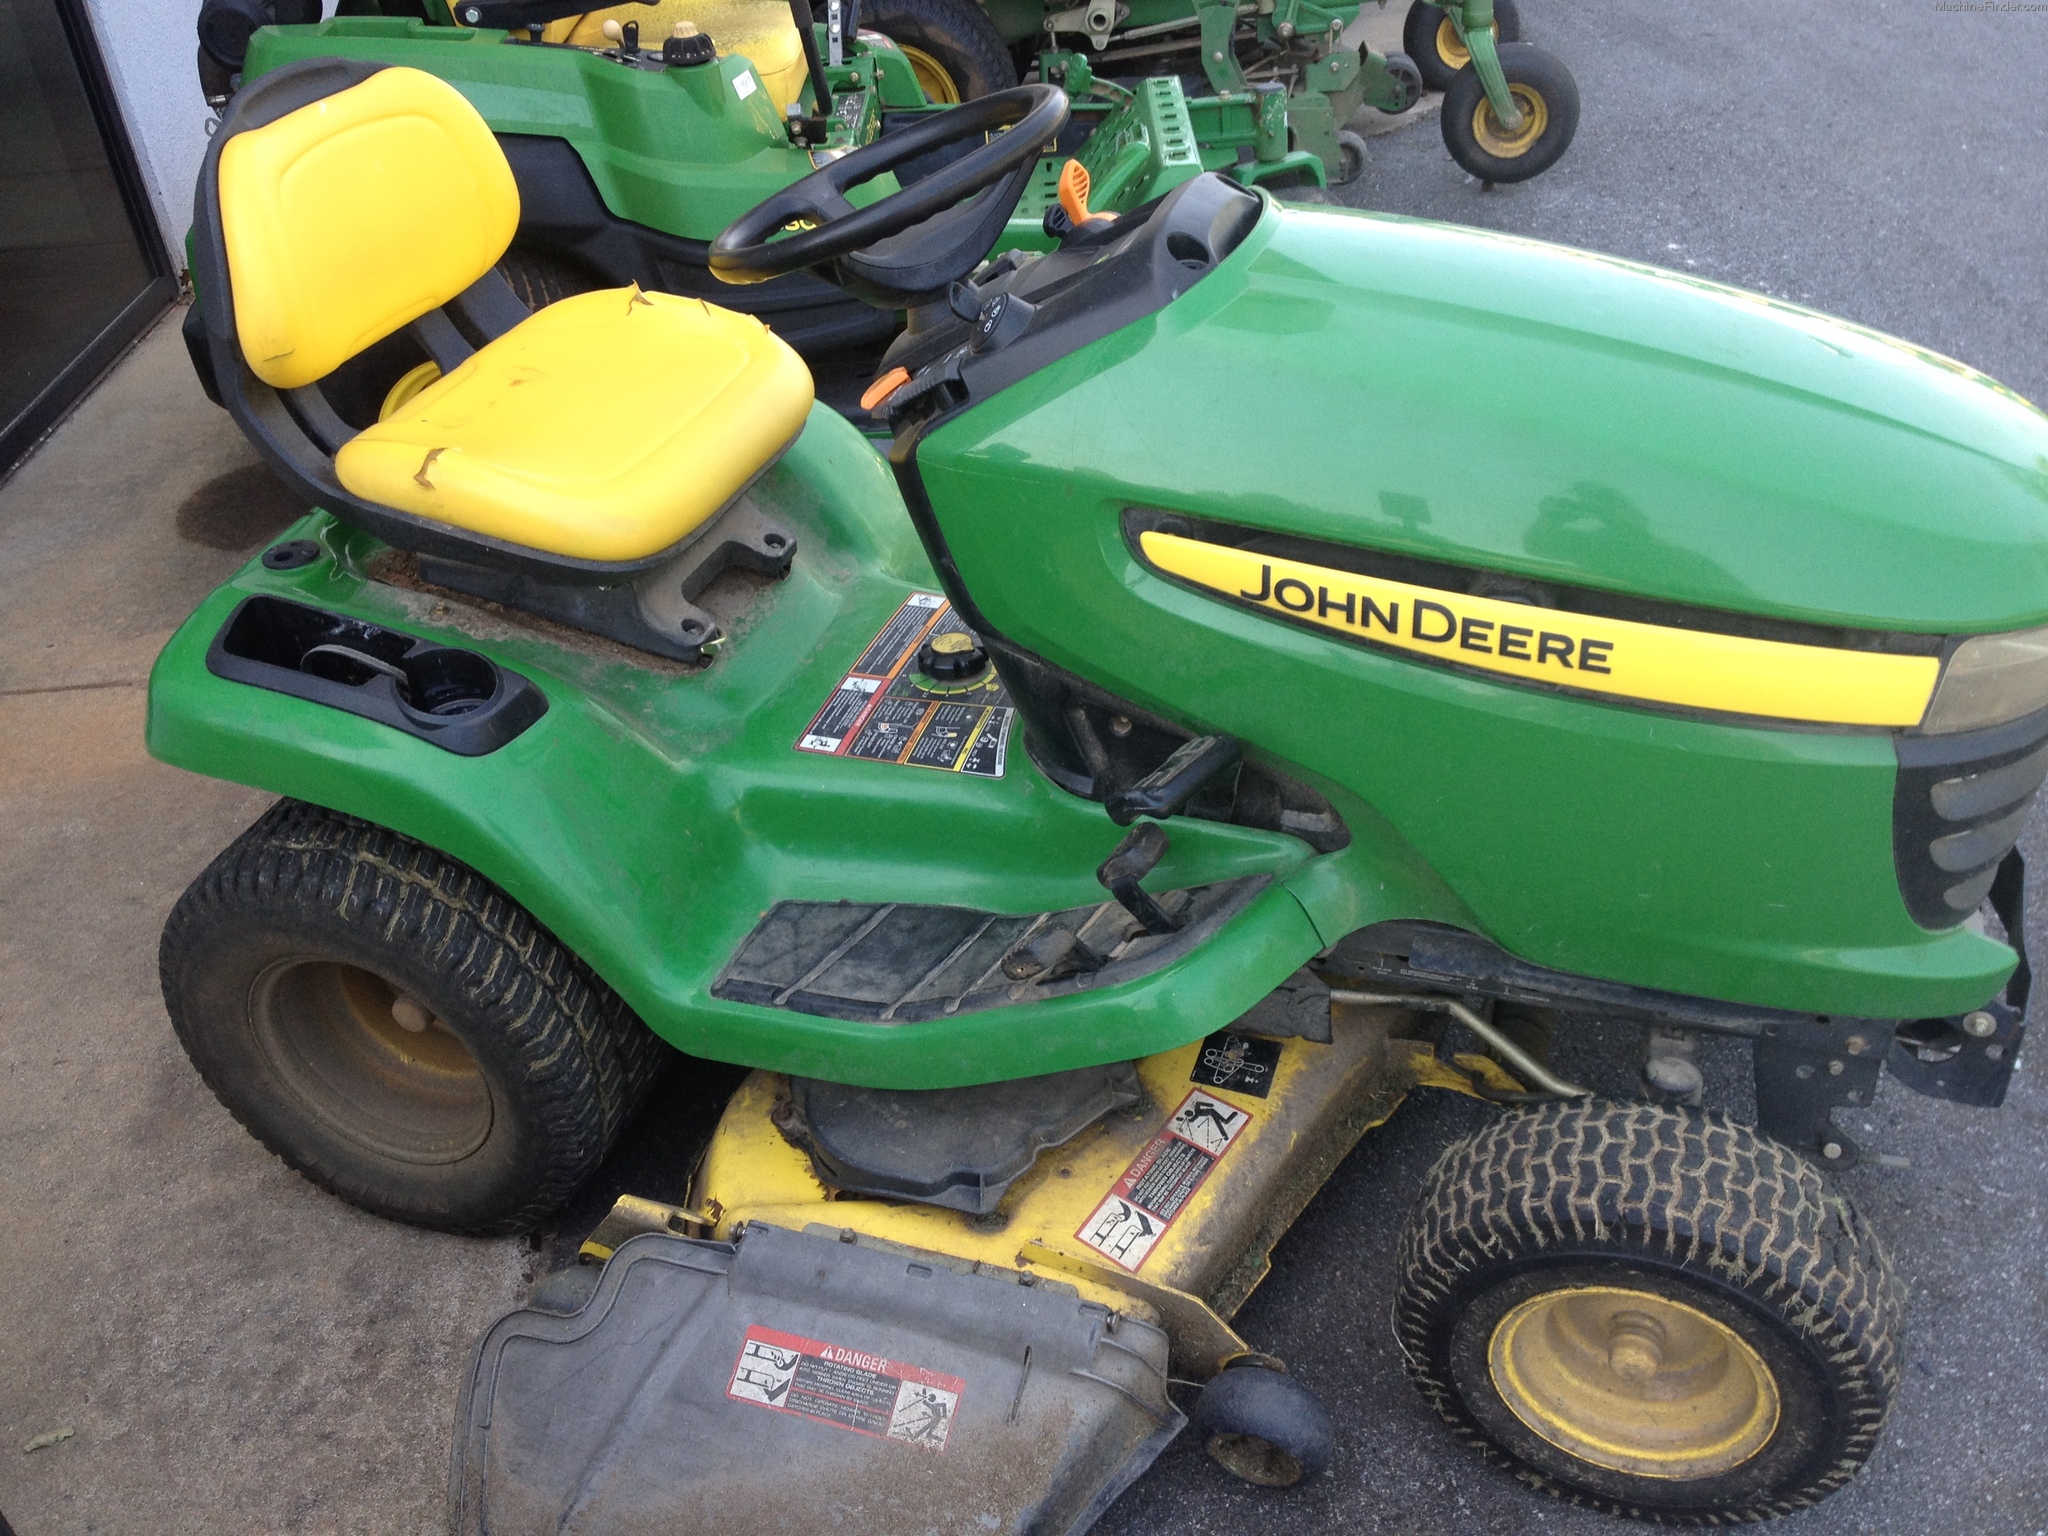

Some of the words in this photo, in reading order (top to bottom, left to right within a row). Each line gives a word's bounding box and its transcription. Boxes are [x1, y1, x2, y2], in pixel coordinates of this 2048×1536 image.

[1240, 564, 1399, 634] JOHN
[1412, 599, 1614, 675] DEERE
[1129, 1137, 1165, 1177] DANGER
[1135, 1163, 1158, 1189] ROTATING
[1154, 1146, 1172, 1165] BLADE
[1147, 1175, 1168, 1199] THROWN
[1164, 1152, 1186, 1177] OBJECTS
[823, 1360, 855, 1373] ROTATING
[855, 1369, 877, 1378] BLADE
[836, 1348, 888, 1374] DANGER
[815, 1375, 844, 1387] THROWN
[844, 1383, 874, 1395] OBJECTS
